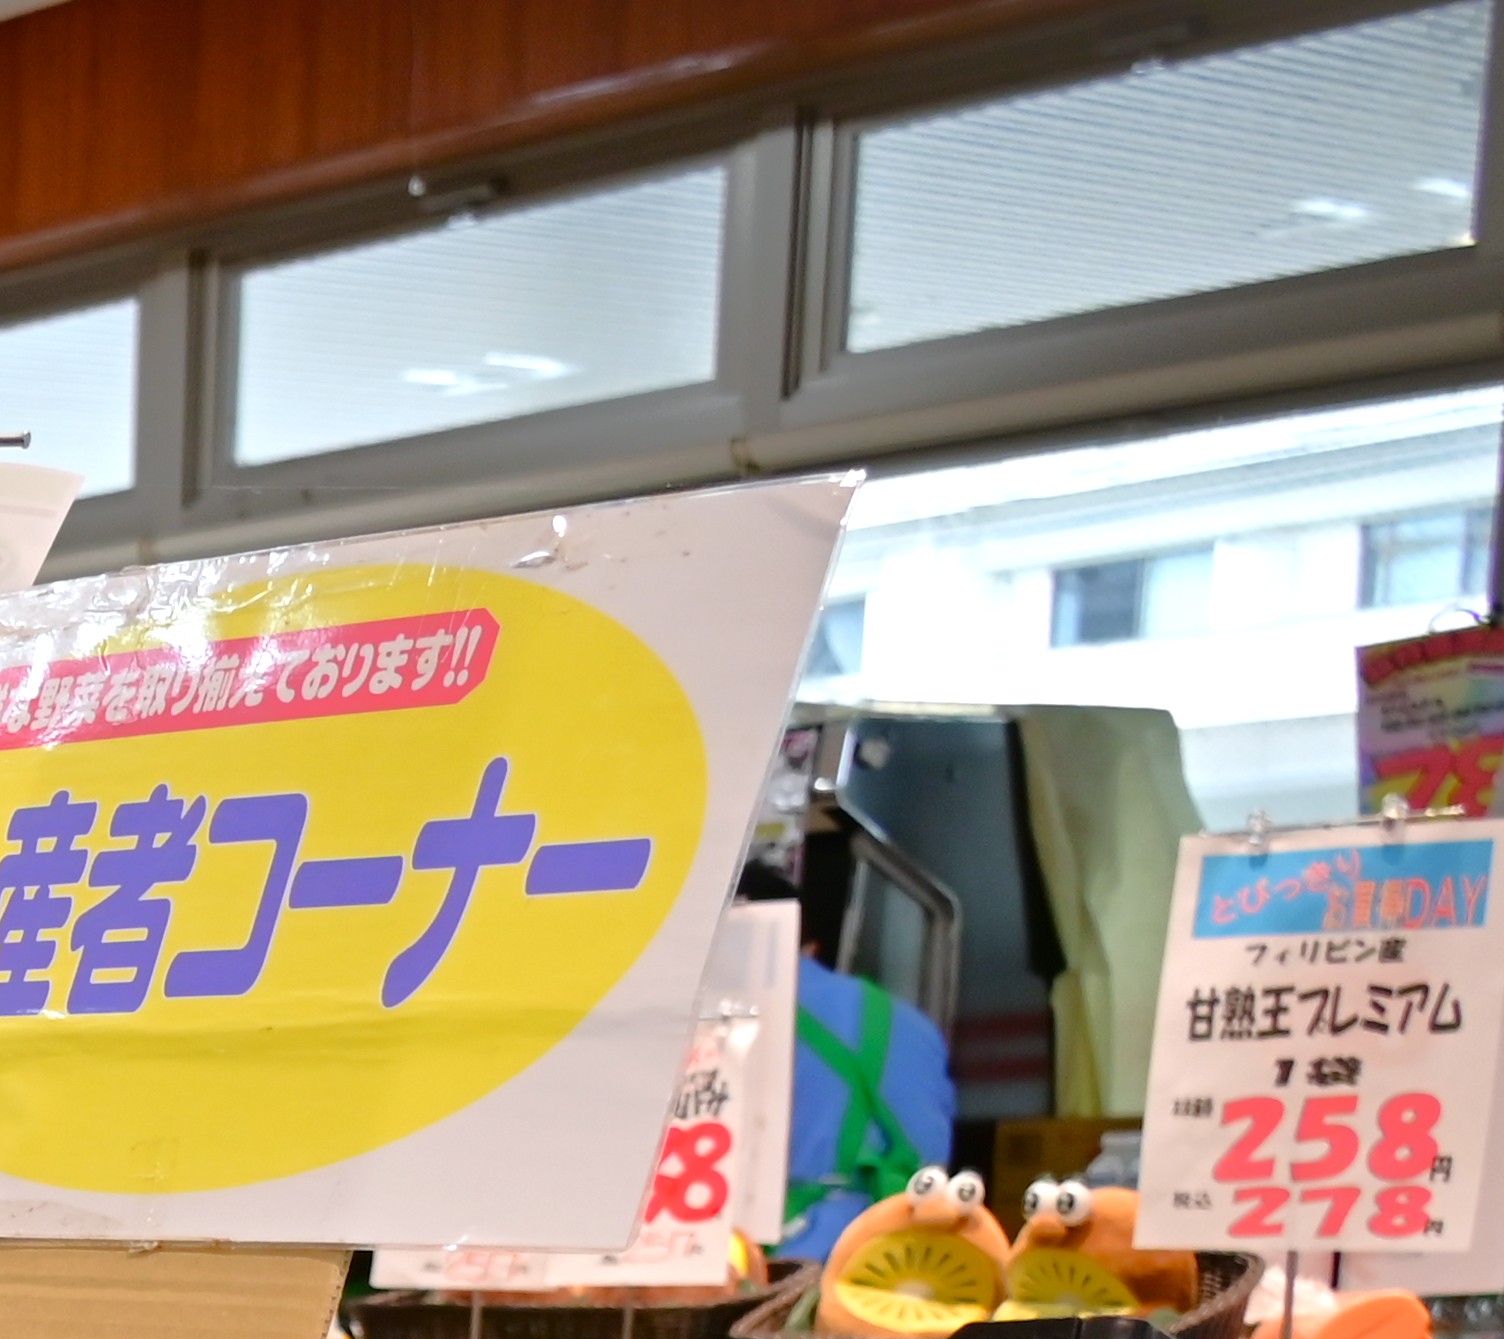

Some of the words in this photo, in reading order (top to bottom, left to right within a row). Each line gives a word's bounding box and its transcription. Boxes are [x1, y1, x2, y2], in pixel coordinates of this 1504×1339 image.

[1244, 938, 1407, 965] フィリピン産
[1186, 980, 1463, 1042] 甘熟王プレミアム
[1212, 1092, 1443, 1184] 258
[1430, 1156, 1453, 1183] 円
[1227, 1184, 1433, 1239] 278
